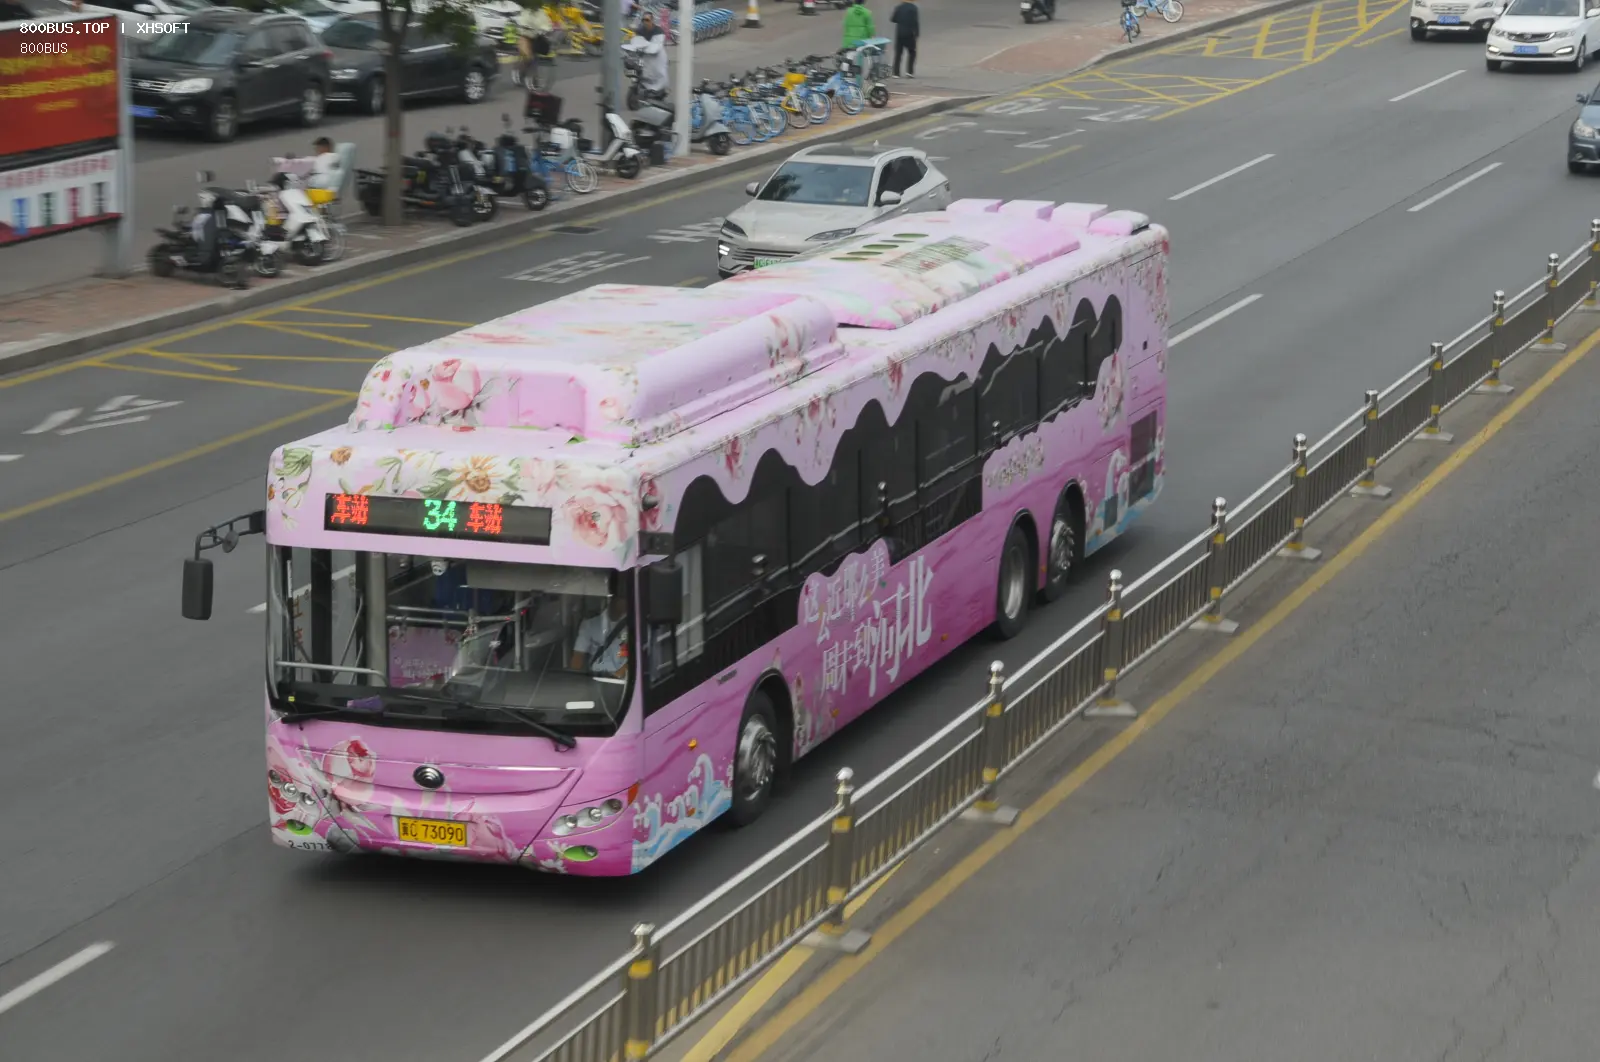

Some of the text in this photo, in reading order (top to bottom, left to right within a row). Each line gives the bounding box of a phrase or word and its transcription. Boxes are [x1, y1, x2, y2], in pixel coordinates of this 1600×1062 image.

[422, 499, 459, 532] 34
[820, 554, 933, 699] 周末到河北
[421, 823, 464, 842] 73090
